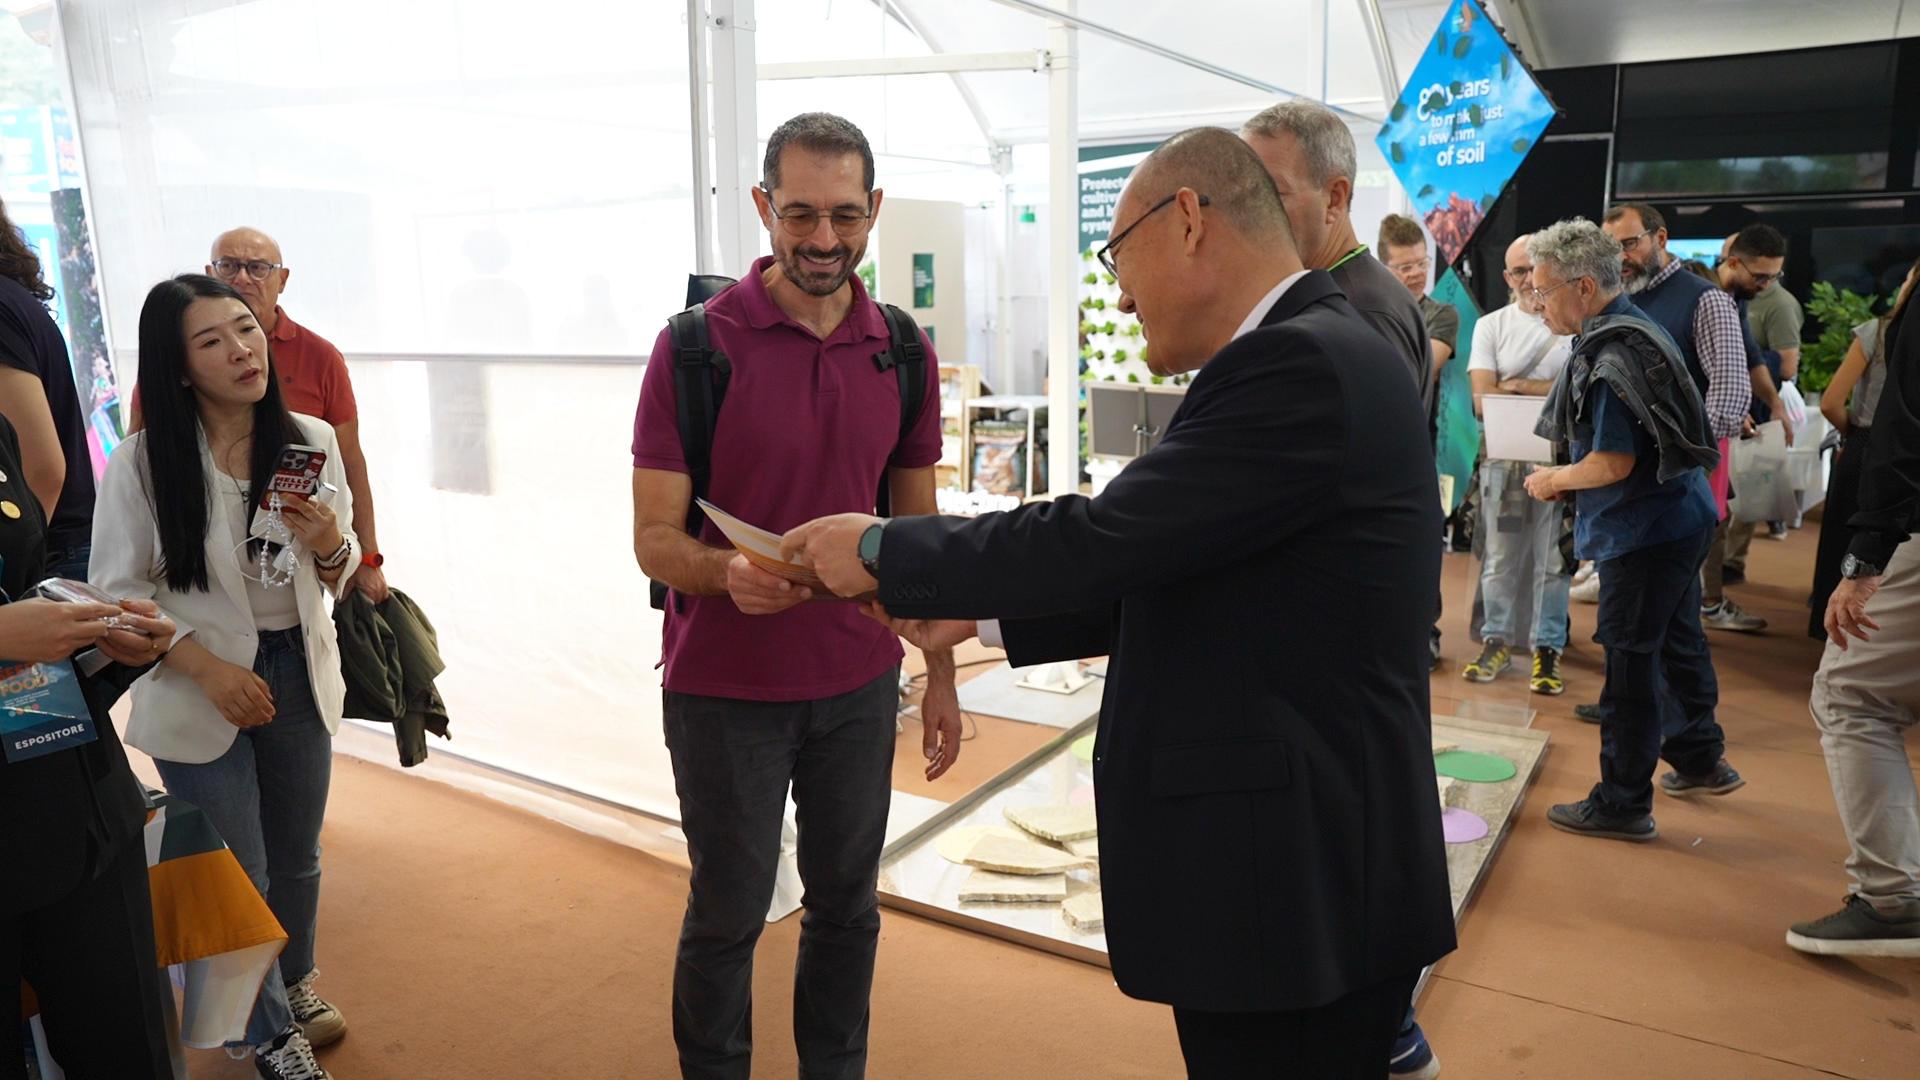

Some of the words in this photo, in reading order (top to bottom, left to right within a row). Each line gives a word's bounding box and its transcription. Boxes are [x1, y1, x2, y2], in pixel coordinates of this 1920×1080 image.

[1431, 114, 1443, 127] to
[1445, 108, 1474, 125] mak
[1480, 104, 1503, 122] just
[1419, 134, 1427, 147] a
[1428, 131, 1448, 146] few
[1437, 145, 1455, 167] of
[1456, 140, 1485, 165] soil
[1081, 177, 1125, 191] Protect
[1081, 190, 1119, 204] cultiv
[1081, 205, 1105, 218] and
[275, 482, 309, 490] KITTY
[276, 477, 311, 485] HELLO
[15, 723, 85, 750] ESPOSITORE
